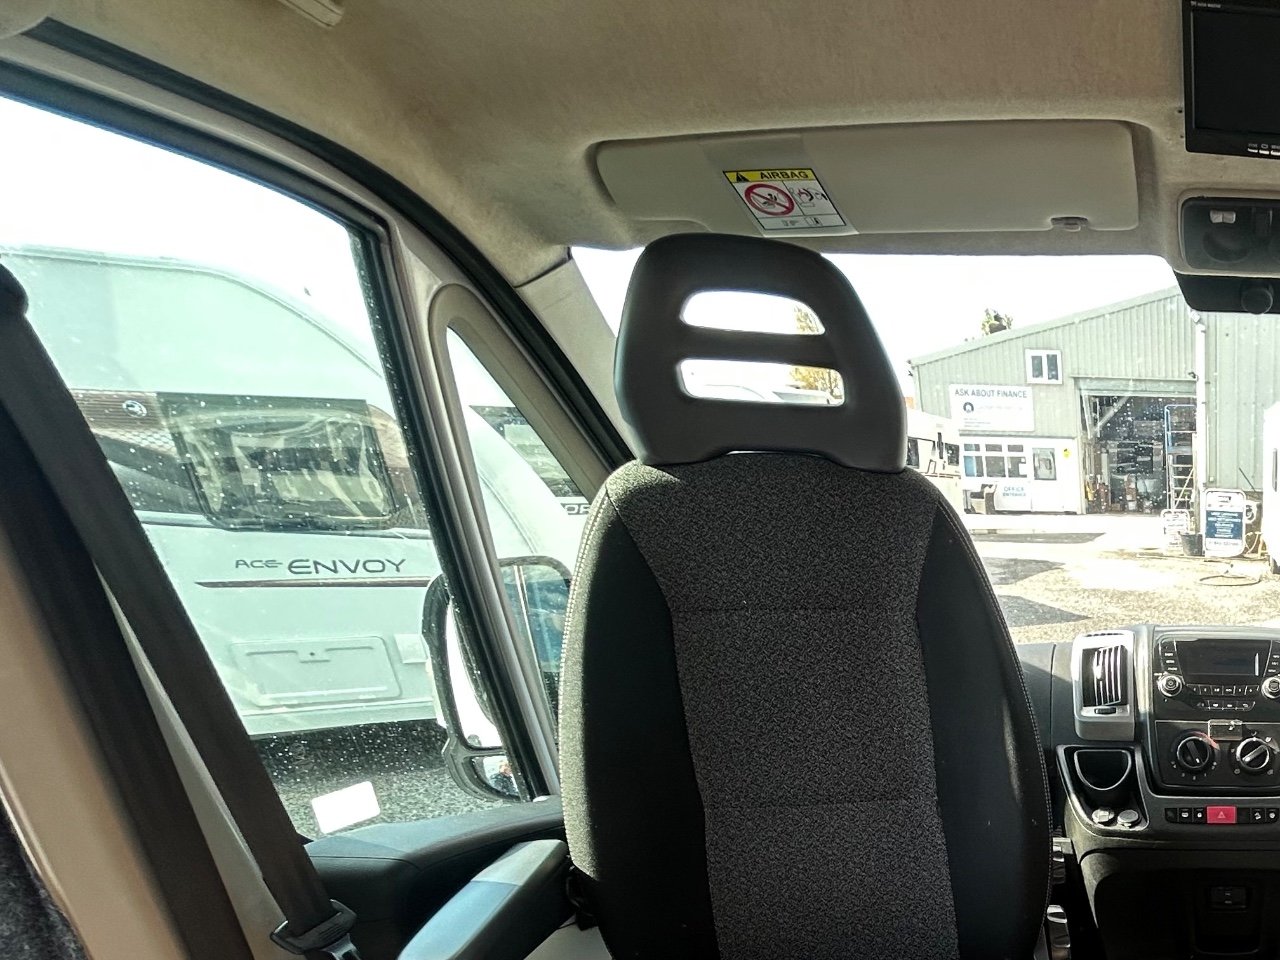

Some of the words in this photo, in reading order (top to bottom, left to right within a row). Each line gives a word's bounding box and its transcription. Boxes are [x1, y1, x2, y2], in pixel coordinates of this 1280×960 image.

[760, 171, 809, 180] AIRBAG
[954, 388, 970, 397] ASK
[971, 389, 995, 398] ABOUT
[996, 389, 1028, 399] FINANCE
[235, 559, 283, 569] ACE
[287, 558, 407, 575] ENVOY
